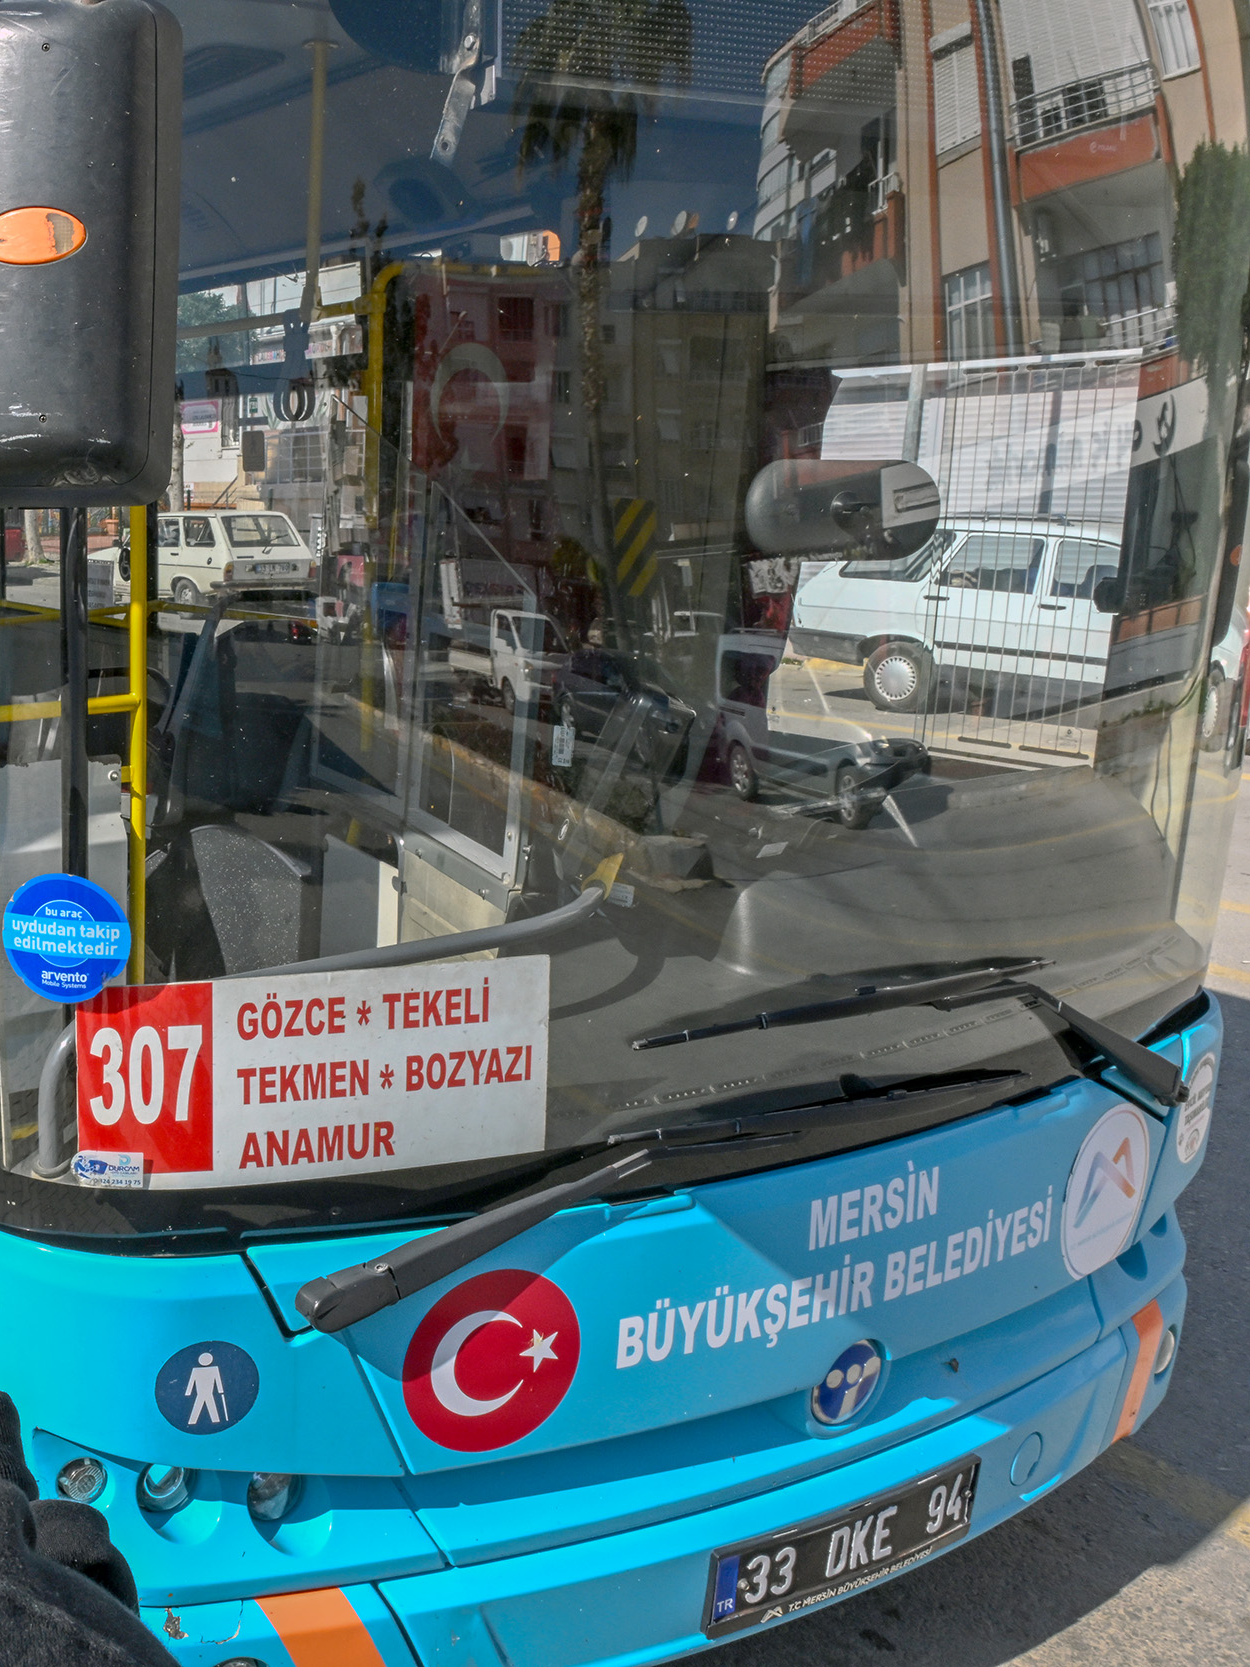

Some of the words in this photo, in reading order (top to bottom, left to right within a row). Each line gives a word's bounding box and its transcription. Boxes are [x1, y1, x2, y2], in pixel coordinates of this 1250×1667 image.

[12, 919, 76, 937] uydudan
[80, 925, 120, 942] takip
[45, 906, 58, 916] bu
[59, 910, 83, 921] araç
[14, 936, 118, 956] edilmektedir
[41, 970, 88, 983] arvento
[42, 979, 60, 987] Mobile
[61, 981, 87, 989] Systems
[237, 993, 346, 1041] GÖZCE
[383, 977, 490, 1030] TEKELİ
[89, 1024, 203, 1126] 307
[237, 1059, 370, 1105] TEKMEN
[405, 1045, 533, 1092] BOZYAZI
[238, 1120, 396, 1169] ANAMUR
[808, 1160, 940, 1251] MERSİN
[616, 1253, 873, 1370] BÜYÜKŞEHİR
[883, 1185, 1054, 1302] BELEDİYESİ
[745, 1547, 797, 1603] 33
[825, 1505, 898, 1578] DKE
[926, 1473, 963, 1534] 94
[717, 1597, 735, 1613] TR
[802, 1587, 836, 1607] MERSİN
